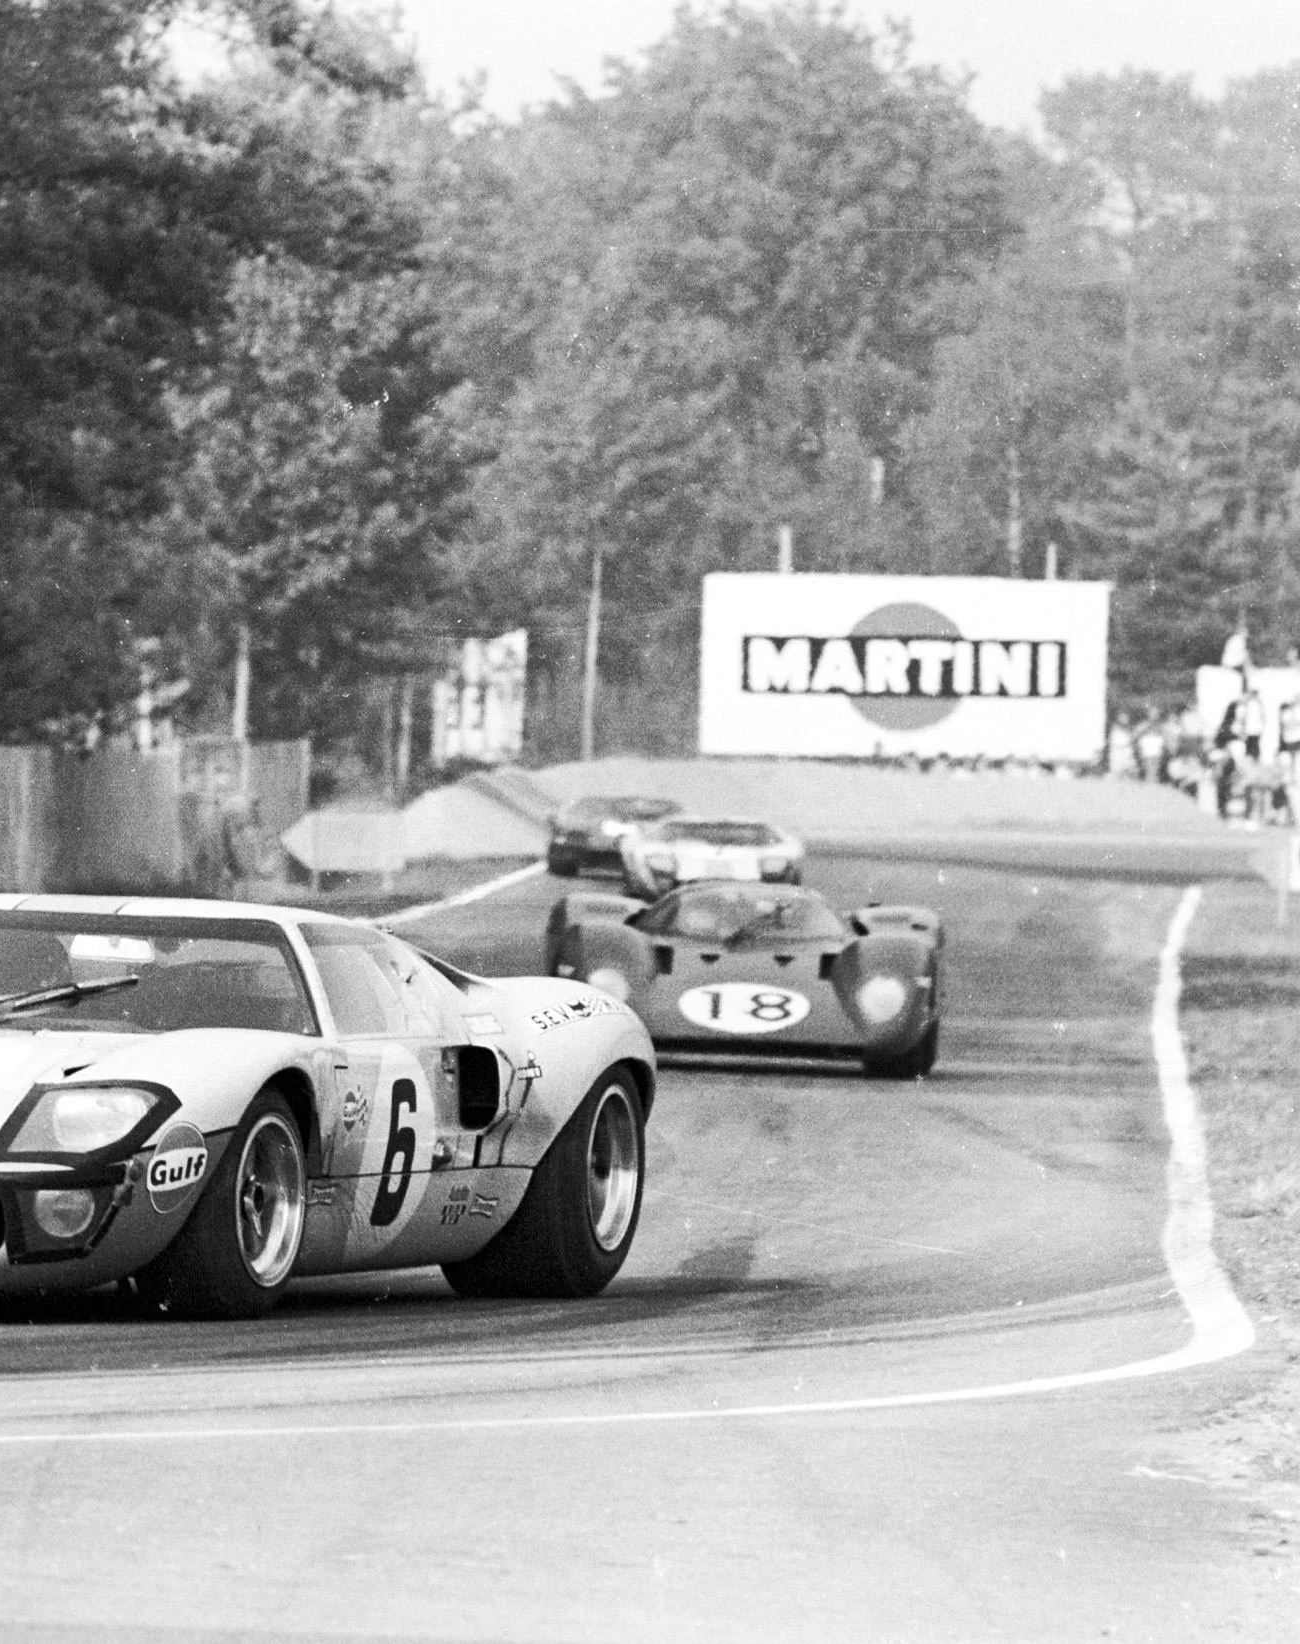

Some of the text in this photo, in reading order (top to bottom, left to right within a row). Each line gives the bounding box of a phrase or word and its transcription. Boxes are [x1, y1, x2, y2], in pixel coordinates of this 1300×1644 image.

[745, 636, 1063, 697] MARTINI
[701, 990, 792, 1022] 18
[150, 1153, 205, 1187] Gulf
[369, 1078, 417, 1227] 6
